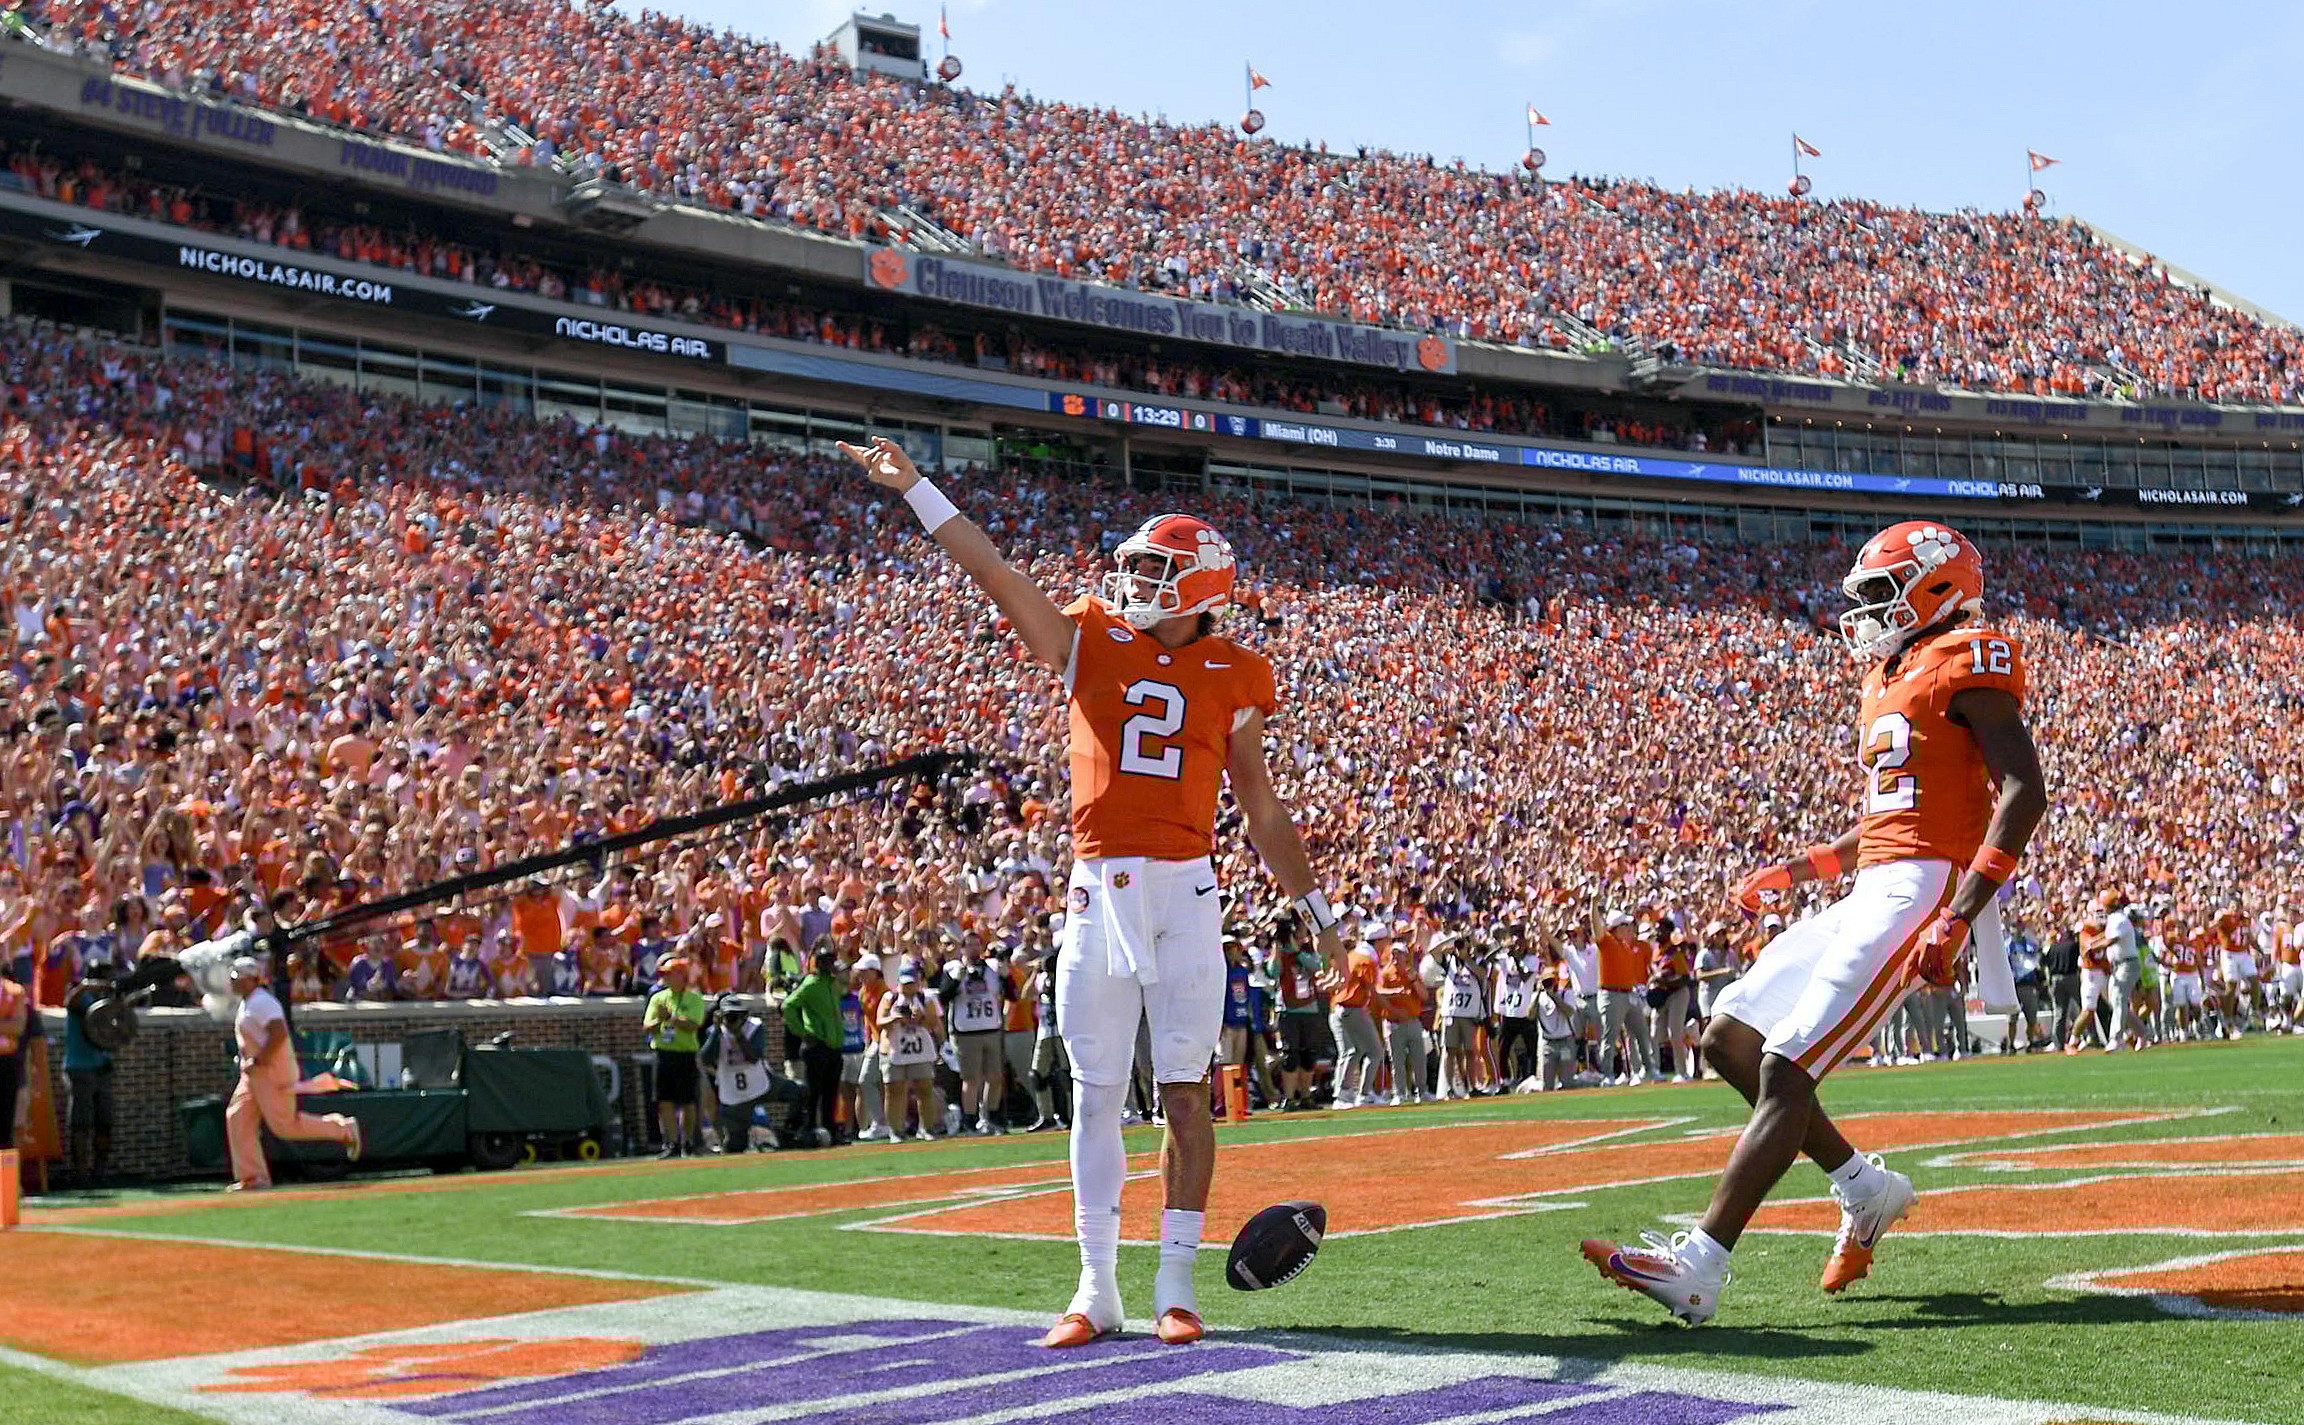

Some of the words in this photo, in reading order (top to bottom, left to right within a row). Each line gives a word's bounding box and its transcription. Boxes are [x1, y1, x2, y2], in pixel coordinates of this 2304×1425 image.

[179, 247, 392, 305] NICHOLASAIR.COM
[915, 257, 1033, 312] Clemson
[1036, 278, 1174, 333] Welcomes
[1176, 302, 1226, 342] You
[1229, 311, 1256, 346] to
[1261, 315, 1333, 356] Death
[1336, 325, 1410, 371] Valley
[556, 316, 667, 355] NICHOLAS
[1107, 402, 1119, 418] 0
[1133, 405, 1181, 427] 13:29
[1194, 414, 1206, 429] 0
[1265, 422, 1306, 442] Miami
[1308, 427, 1338, 447] (OH)
[1374, 436, 1397, 450] 3:30
[1425, 441, 1461, 459] Notre
[1463, 444, 1500, 461] Dame
[1536, 450, 1612, 472] NICHOLAS
[1738, 468, 1854, 490] NICHOLASAIR.COM
[1948, 480, 2018, 499] NICHOLAS
[2138, 488, 2249, 506] NICHOLASAIR.COM
[1968, 639, 2013, 676] 12
[1119, 677, 1187, 782] 2
[734, 1071, 748, 1091] 8
